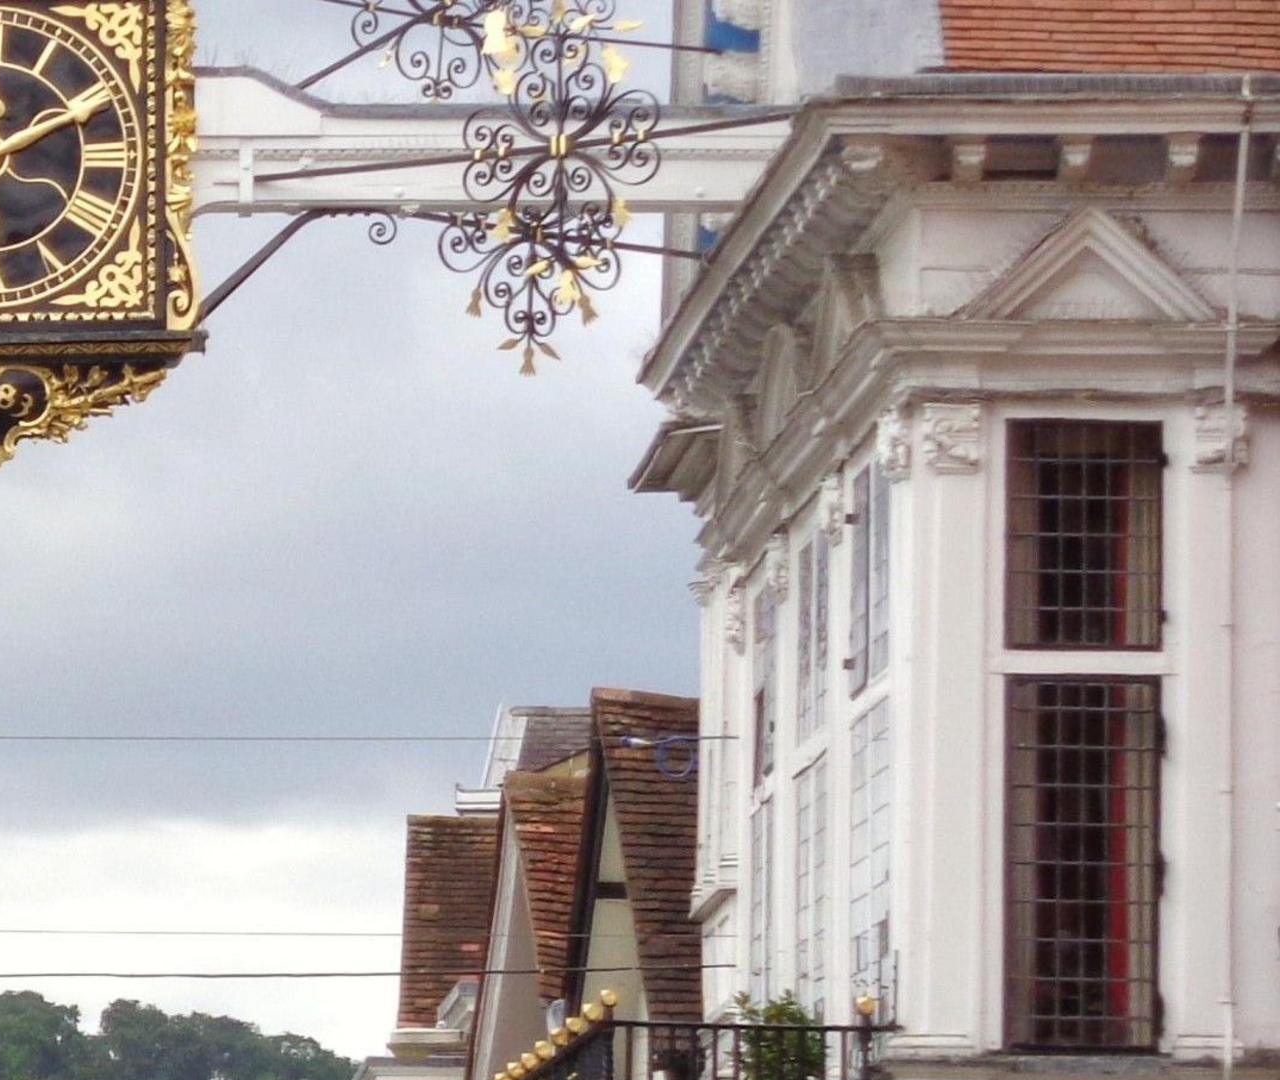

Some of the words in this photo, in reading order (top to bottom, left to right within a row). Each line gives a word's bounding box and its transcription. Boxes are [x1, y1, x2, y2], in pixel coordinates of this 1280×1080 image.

[32, 38, 58, 74] I
[83, 141, 126, 168] III
[37, 239, 66, 273] V
